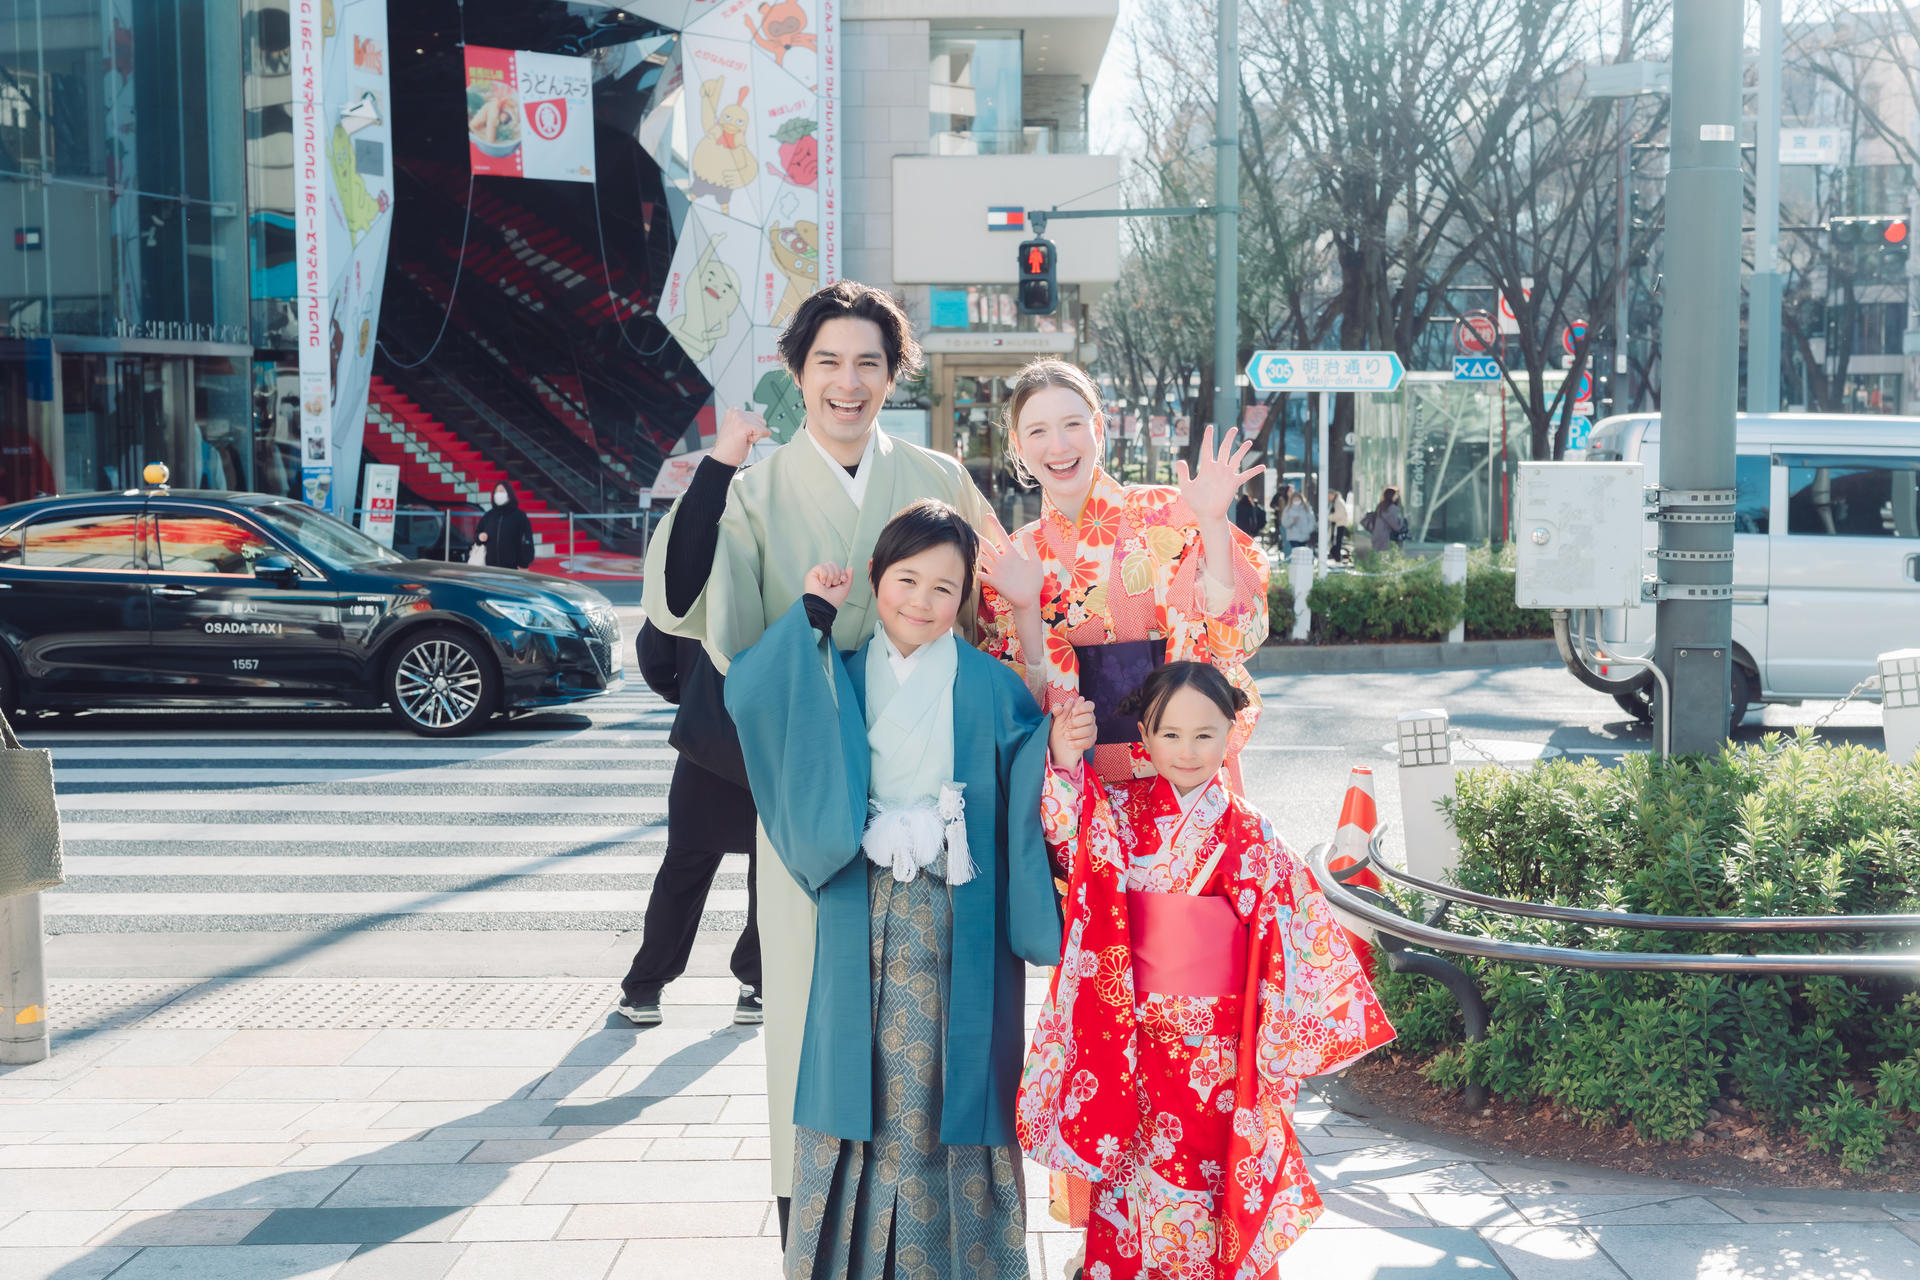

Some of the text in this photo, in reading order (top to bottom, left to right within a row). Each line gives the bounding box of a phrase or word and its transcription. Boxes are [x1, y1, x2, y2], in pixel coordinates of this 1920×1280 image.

[521, 72, 590, 98] うどんスープ
[1268, 363, 1291, 379] 305
[1302, 358, 1381, 376] 明治通り
[204, 622, 283, 635] OSADA TAXI
[232, 659, 260, 670] 1557
